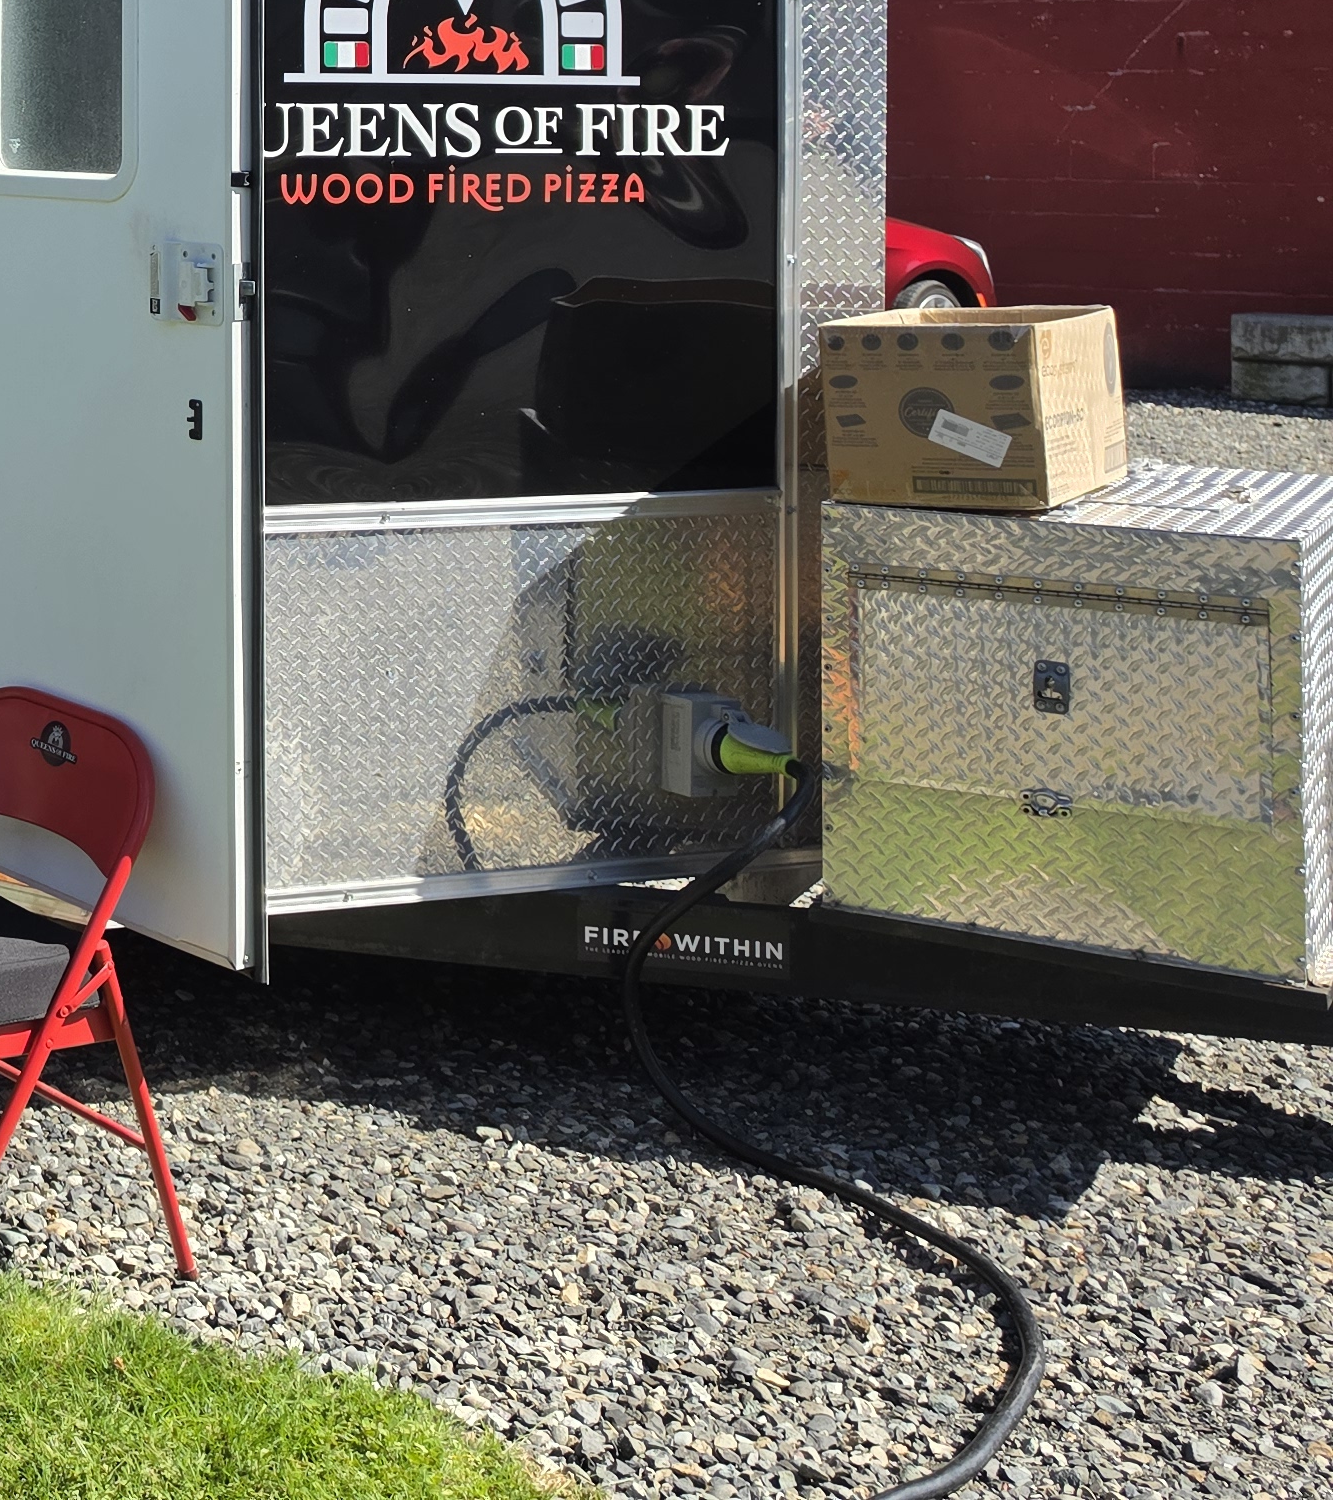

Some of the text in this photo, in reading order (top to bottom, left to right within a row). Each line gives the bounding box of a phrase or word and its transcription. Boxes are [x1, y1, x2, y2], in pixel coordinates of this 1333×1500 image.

[264, 102, 730, 158] UEENS OF FIRE
[280, 173, 414, 205] WOOD
[674, 933, 783, 960] WITHIN
[705, 957, 728, 965] FIRED
[731, 959, 754, 967] PIZZA
[757, 961, 783, 969] OVENS
